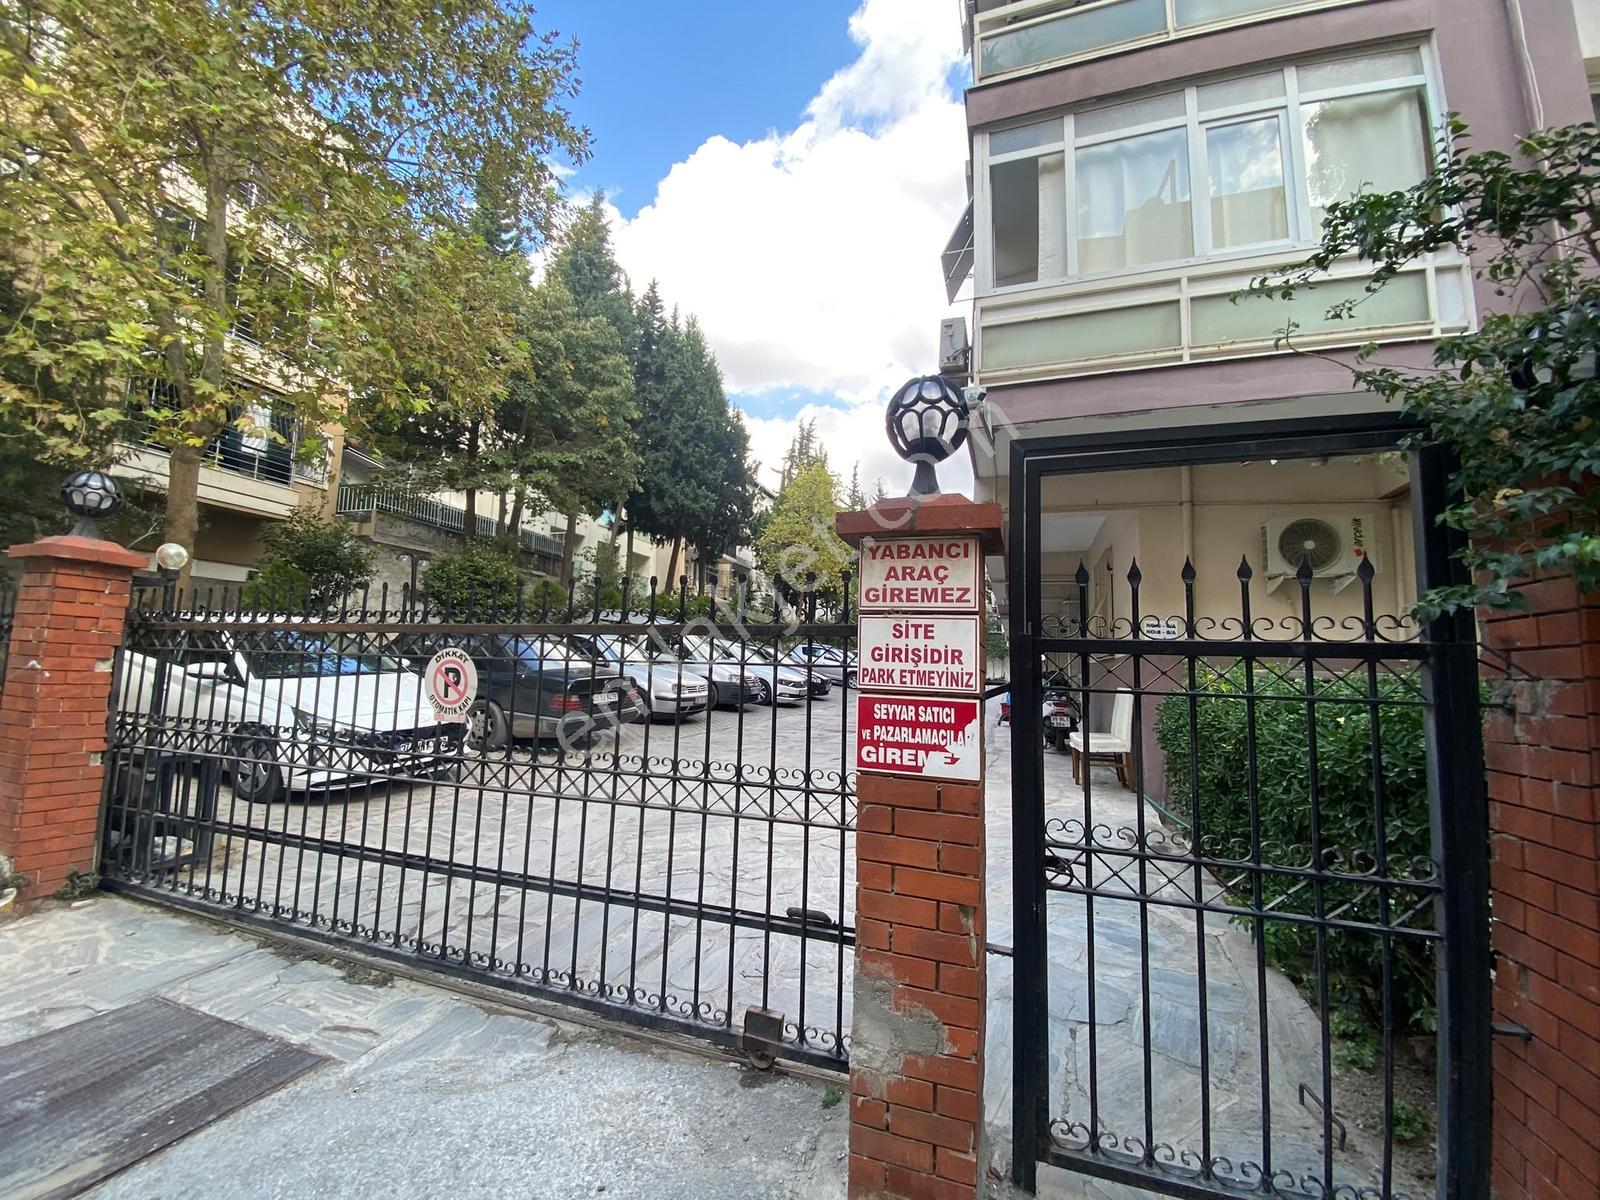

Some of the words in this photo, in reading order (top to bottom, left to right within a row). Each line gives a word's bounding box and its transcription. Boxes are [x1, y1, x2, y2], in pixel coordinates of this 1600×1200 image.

[868, 543, 969, 560] YABANCI
[884, 565, 949, 585] ARAÇ
[864, 584, 971, 603] GİREMEZ
[892, 620, 935, 639] SİTE
[434, 650, 469, 663] DİKKAT
[870, 643, 963, 668] GİRİŞİDİR
[862, 668, 896, 684] PARK
[899, 667, 974, 688] ETMEYİNİZ
[458, 695, 472, 711] KAPI
[874, 703, 915, 721] SEYYAR
[918, 706, 955, 724] SATICI
[861, 729, 871, 740] VE
